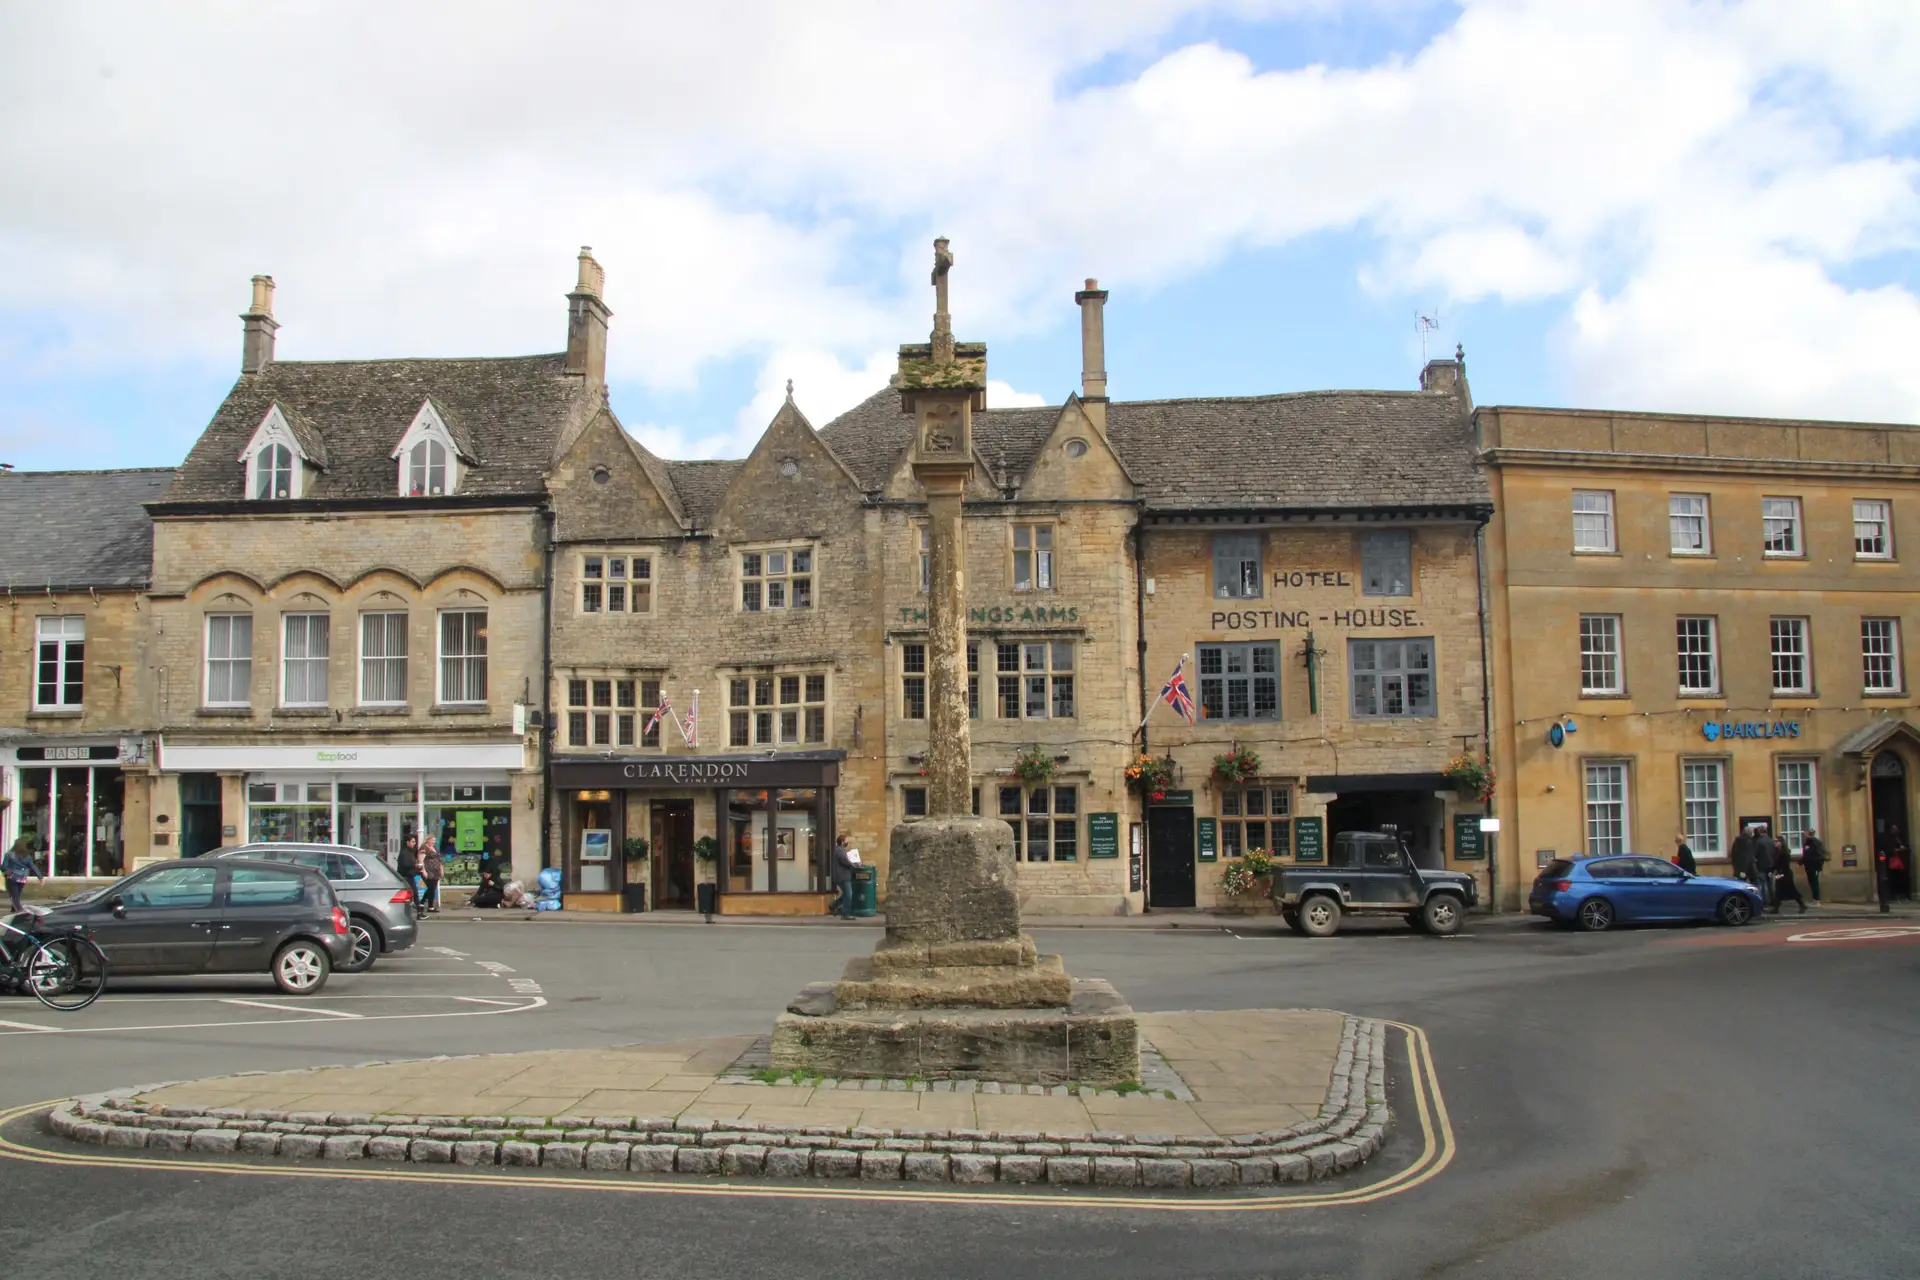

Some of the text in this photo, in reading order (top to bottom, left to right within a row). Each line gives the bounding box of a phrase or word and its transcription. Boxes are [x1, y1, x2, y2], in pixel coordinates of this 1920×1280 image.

[1273, 571, 1351, 588] HOTEL
[899, 606, 1078, 624] TH NGS ARMS
[1211, 610, 1310, 630] POSTING
[1334, 608, 1425, 628] HOUSE.
[1722, 721, 1801, 739] BARCLAYS
[46, 748, 89, 759] MASH
[338, 751, 358, 761] food
[623, 763, 749, 783] CLARENDON
